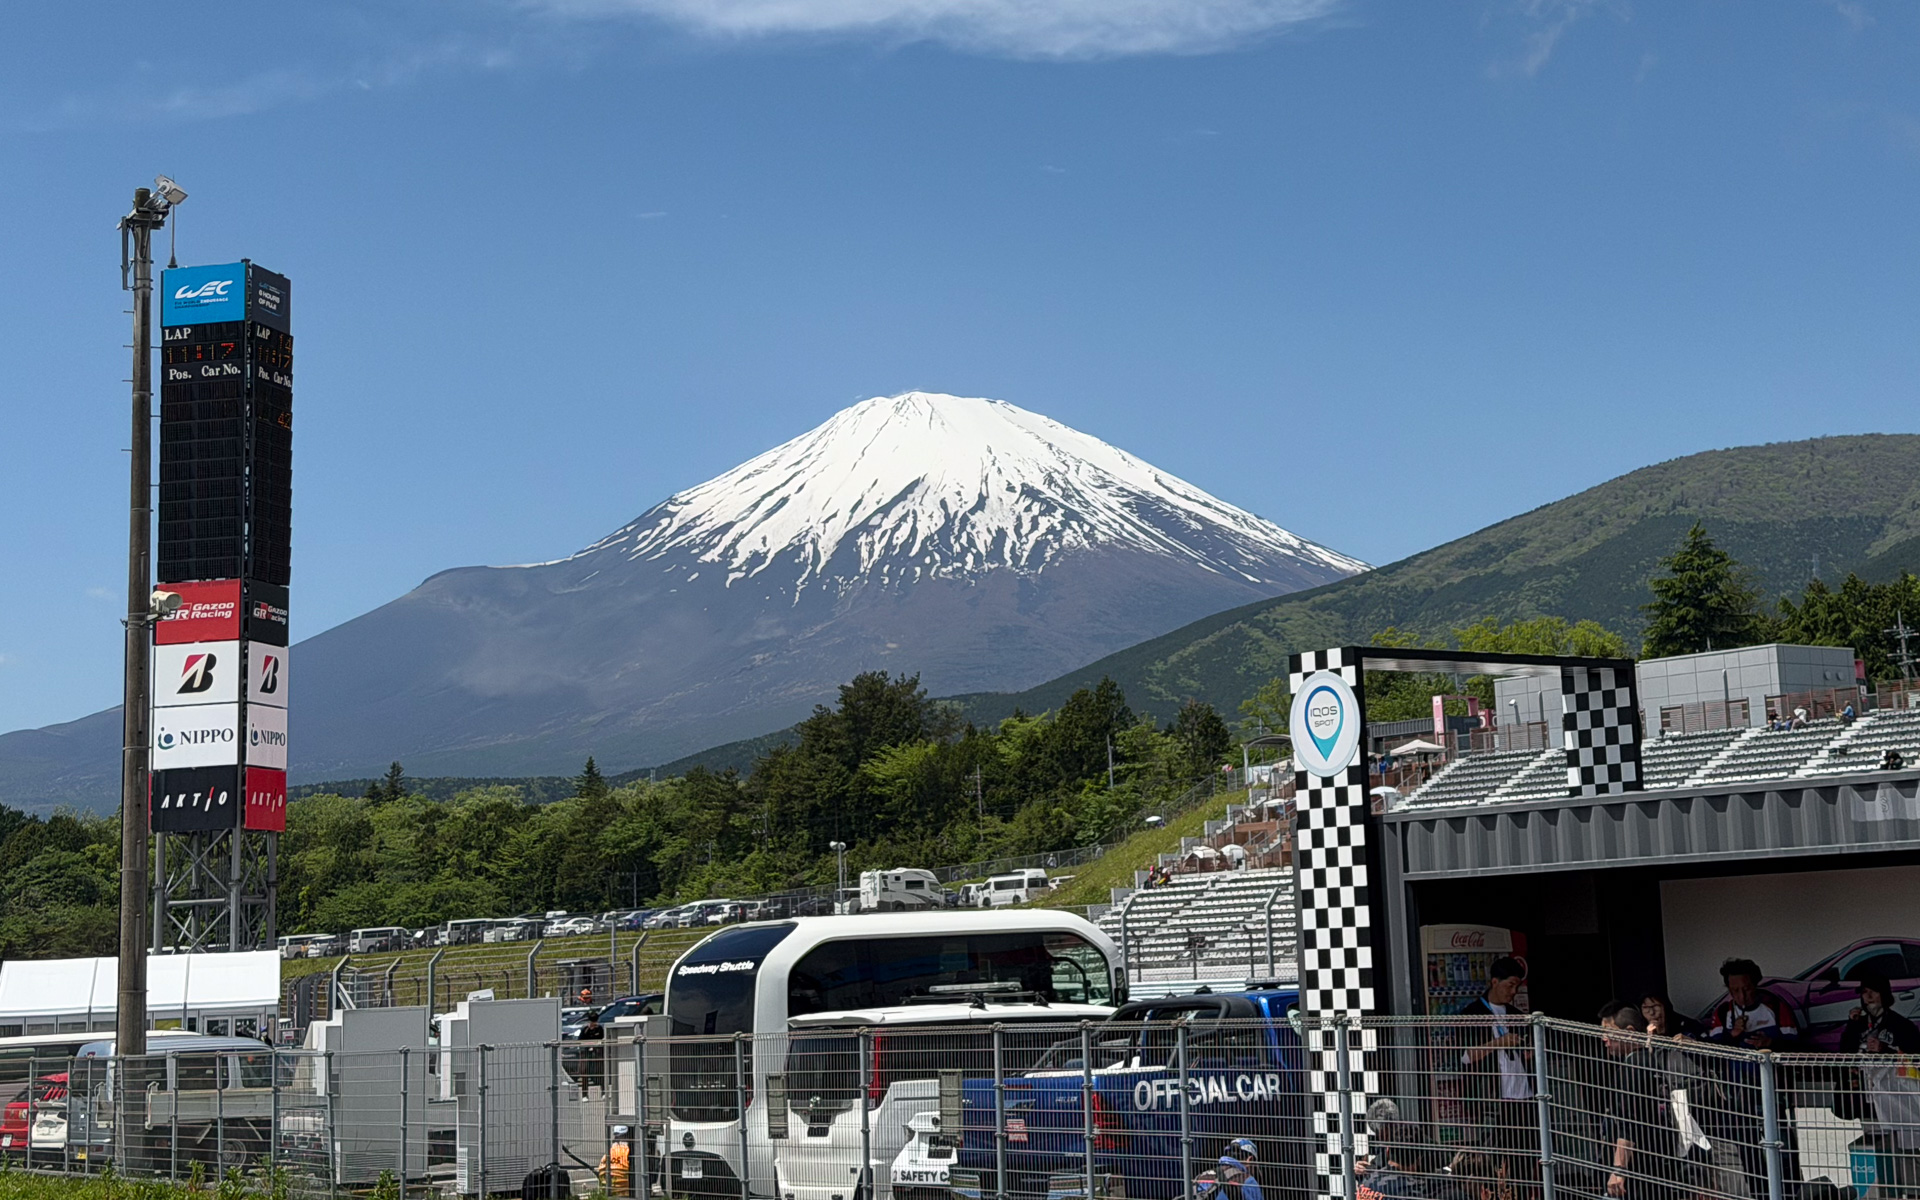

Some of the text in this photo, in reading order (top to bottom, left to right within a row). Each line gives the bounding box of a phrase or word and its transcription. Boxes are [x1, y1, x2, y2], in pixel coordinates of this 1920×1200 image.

[175, 280, 233, 299] WEC
[263, 291, 280, 304] HOURS
[265, 300, 277, 310] FUJI
[164, 327, 191, 341] LAP
[257, 325, 271, 340] LAP
[167, 342, 235, 364] 11:17
[169, 363, 241, 380] Pos. Car No.
[258, 366, 292, 388] Pos. Car No.
[192, 602, 235, 611] GAZOO
[253, 607, 267, 620] GR
[267, 605, 288, 616] GAZOO
[163, 609, 190, 620] GR
[191, 609, 232, 619] Racing
[1310, 705, 1338, 717] IQOS
[1314, 719, 1334, 728] SPOT
[180, 728, 234, 745] NIPPO
[260, 729, 286, 747] NIPPO
[161, 786, 228, 812] AKTIO
[251, 787, 283, 813] AKTIO
[678, 960, 755, 976] Speedway Shuttle
[1134, 1073, 1280, 1111] OFFCIAL CAR
[900, 1170, 938, 1182] SAFETY
